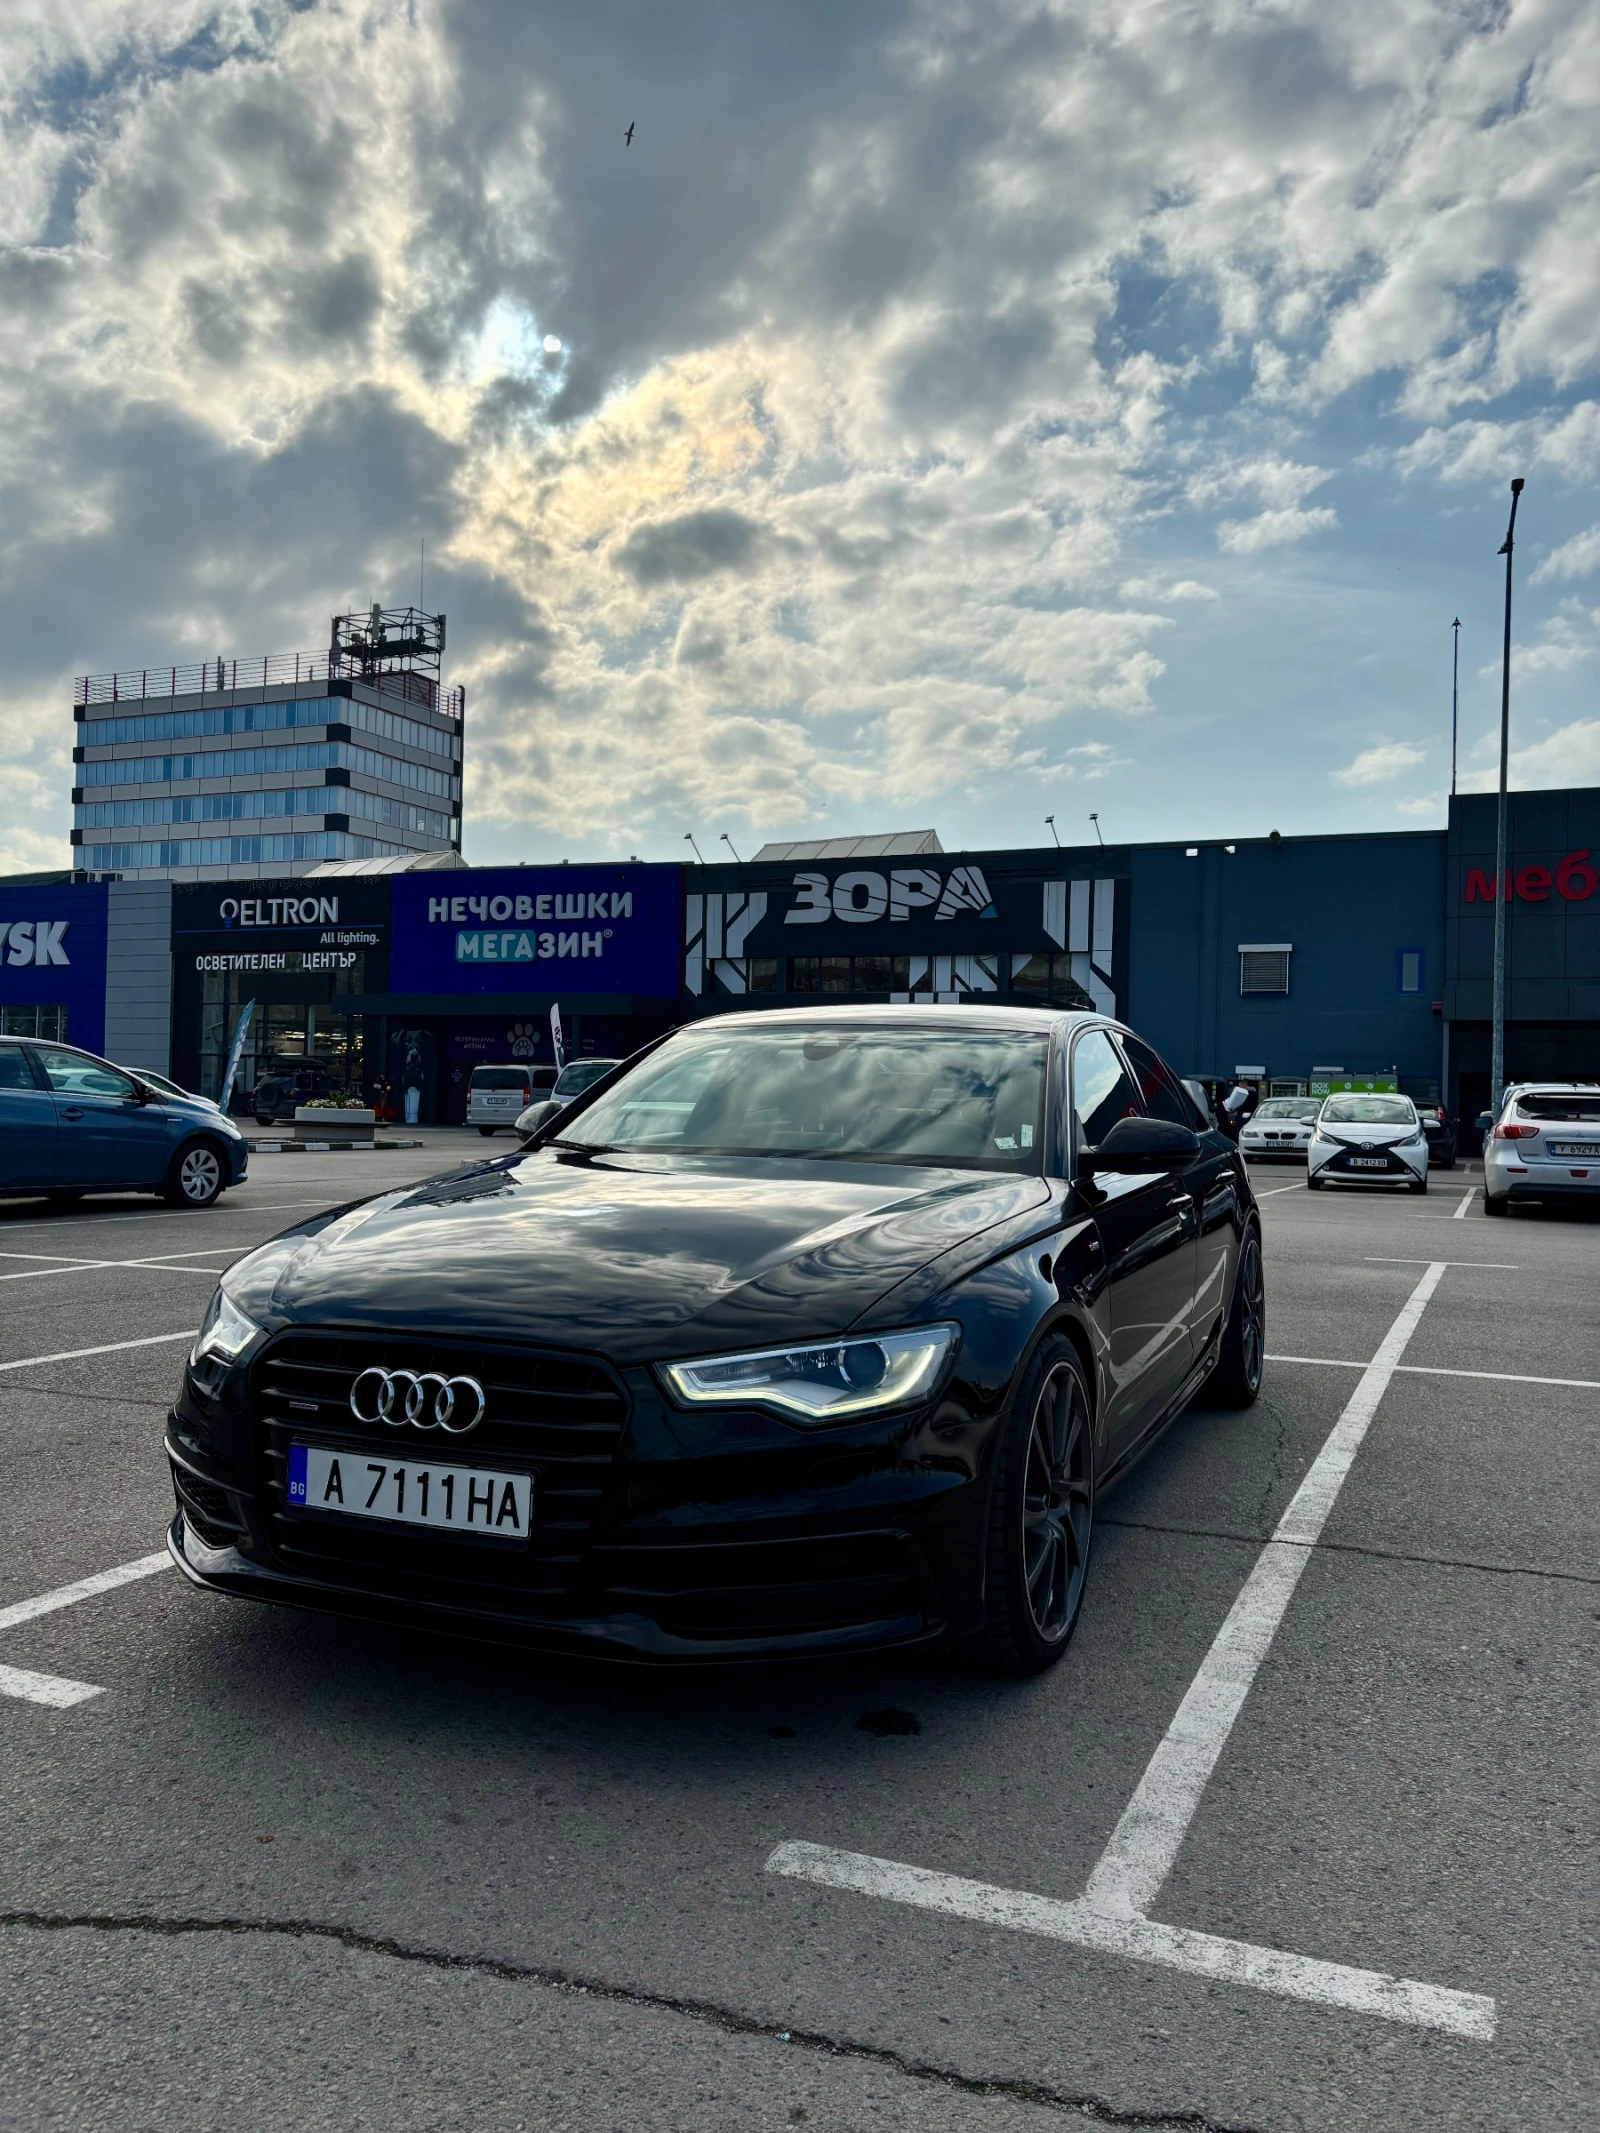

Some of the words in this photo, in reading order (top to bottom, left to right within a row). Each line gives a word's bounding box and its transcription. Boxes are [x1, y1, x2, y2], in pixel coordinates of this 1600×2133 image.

[1464, 849, 1600, 903] меб
[428, 891, 633, 923] НЕЧОВЕШКИ
[783, 865, 999, 925] ЗОРА
[320, 931, 335, 944] All
[196, 953, 285, 971] ОСВЕТИТЕЛЕН
[302, 952, 357, 970] ЦЕНТЪР
[290, 1481, 305, 1496] BG
